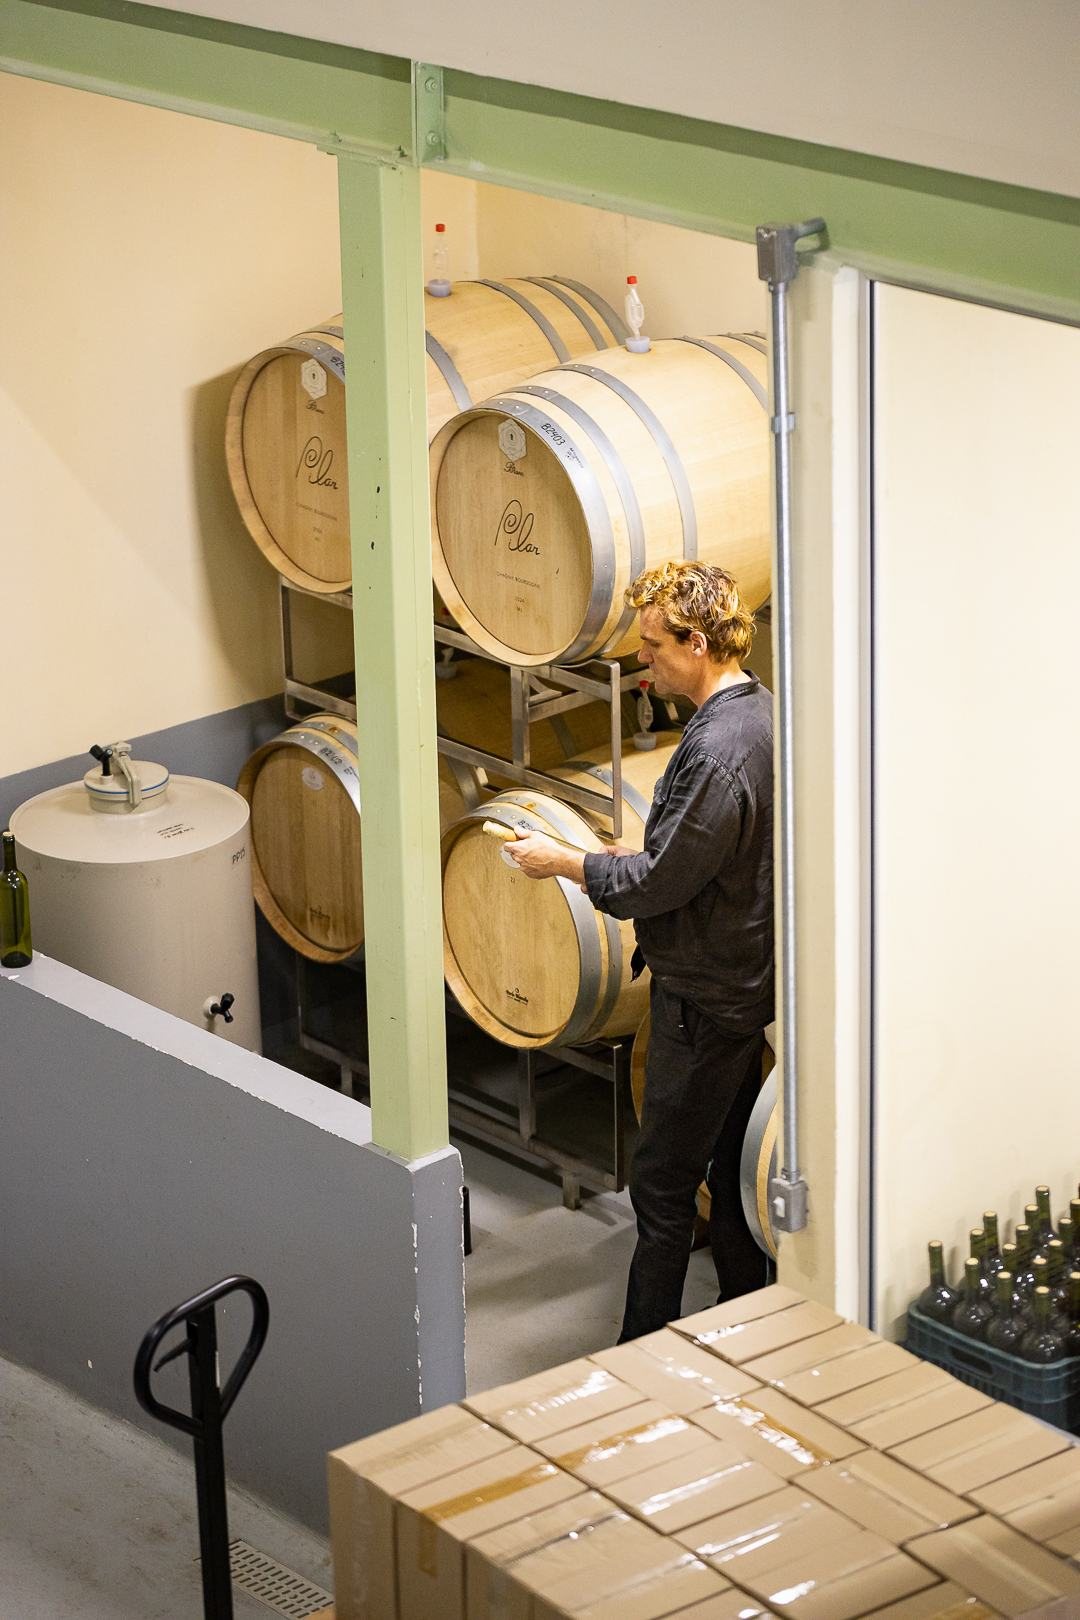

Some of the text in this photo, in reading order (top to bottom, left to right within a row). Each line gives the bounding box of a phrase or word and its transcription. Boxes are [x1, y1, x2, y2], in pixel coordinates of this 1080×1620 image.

[540, 423, 566, 446] B2403
[295, 435, 338, 490] Pilar
[494, 499, 541, 555] Pilar
